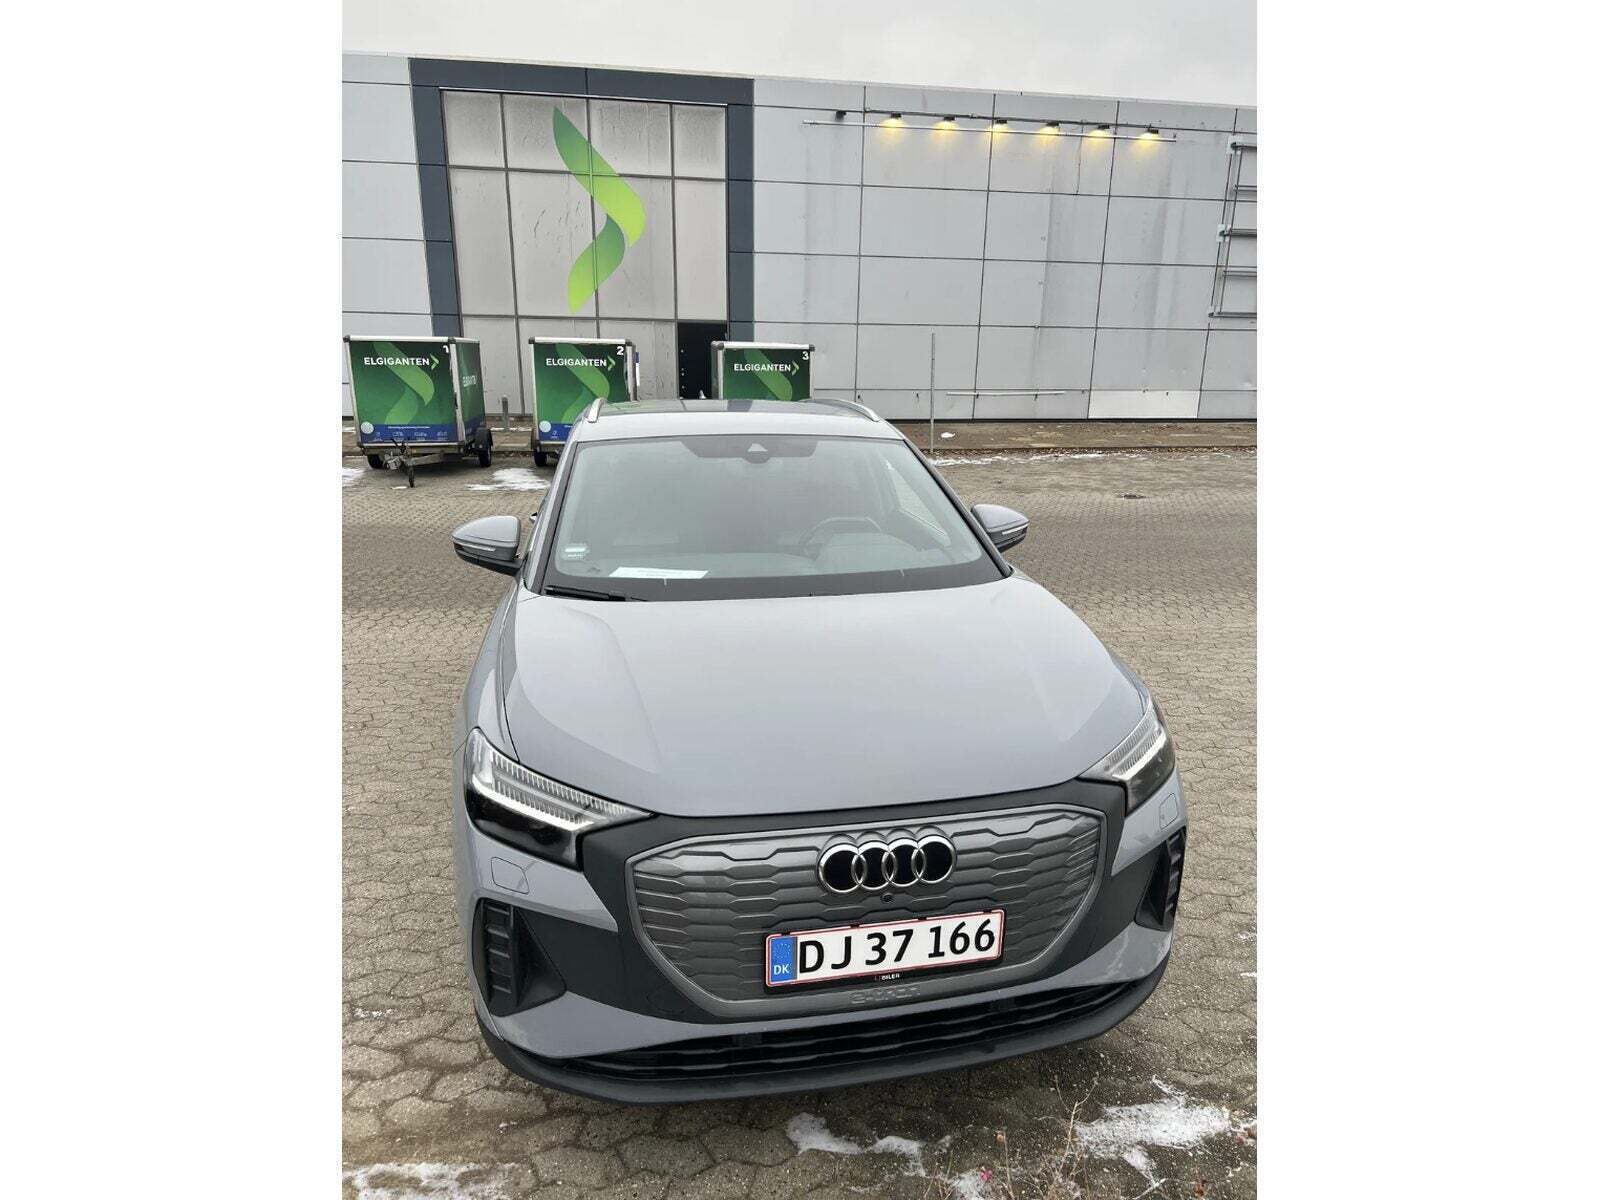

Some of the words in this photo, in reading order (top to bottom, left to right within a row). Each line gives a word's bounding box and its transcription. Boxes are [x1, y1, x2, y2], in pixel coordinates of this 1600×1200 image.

[616, 346, 624, 355] 2
[802, 351, 809, 360] 3
[363, 357, 429, 366] ELGIGANTEN
[546, 358, 607, 367] ELGIGANTEN
[733, 363, 791, 372] ELGIGANTEN
[799, 936, 852, 973] DJ
[865, 929, 914, 966] 37
[928, 918, 996, 958] 166
[773, 964, 790, 975] DK
